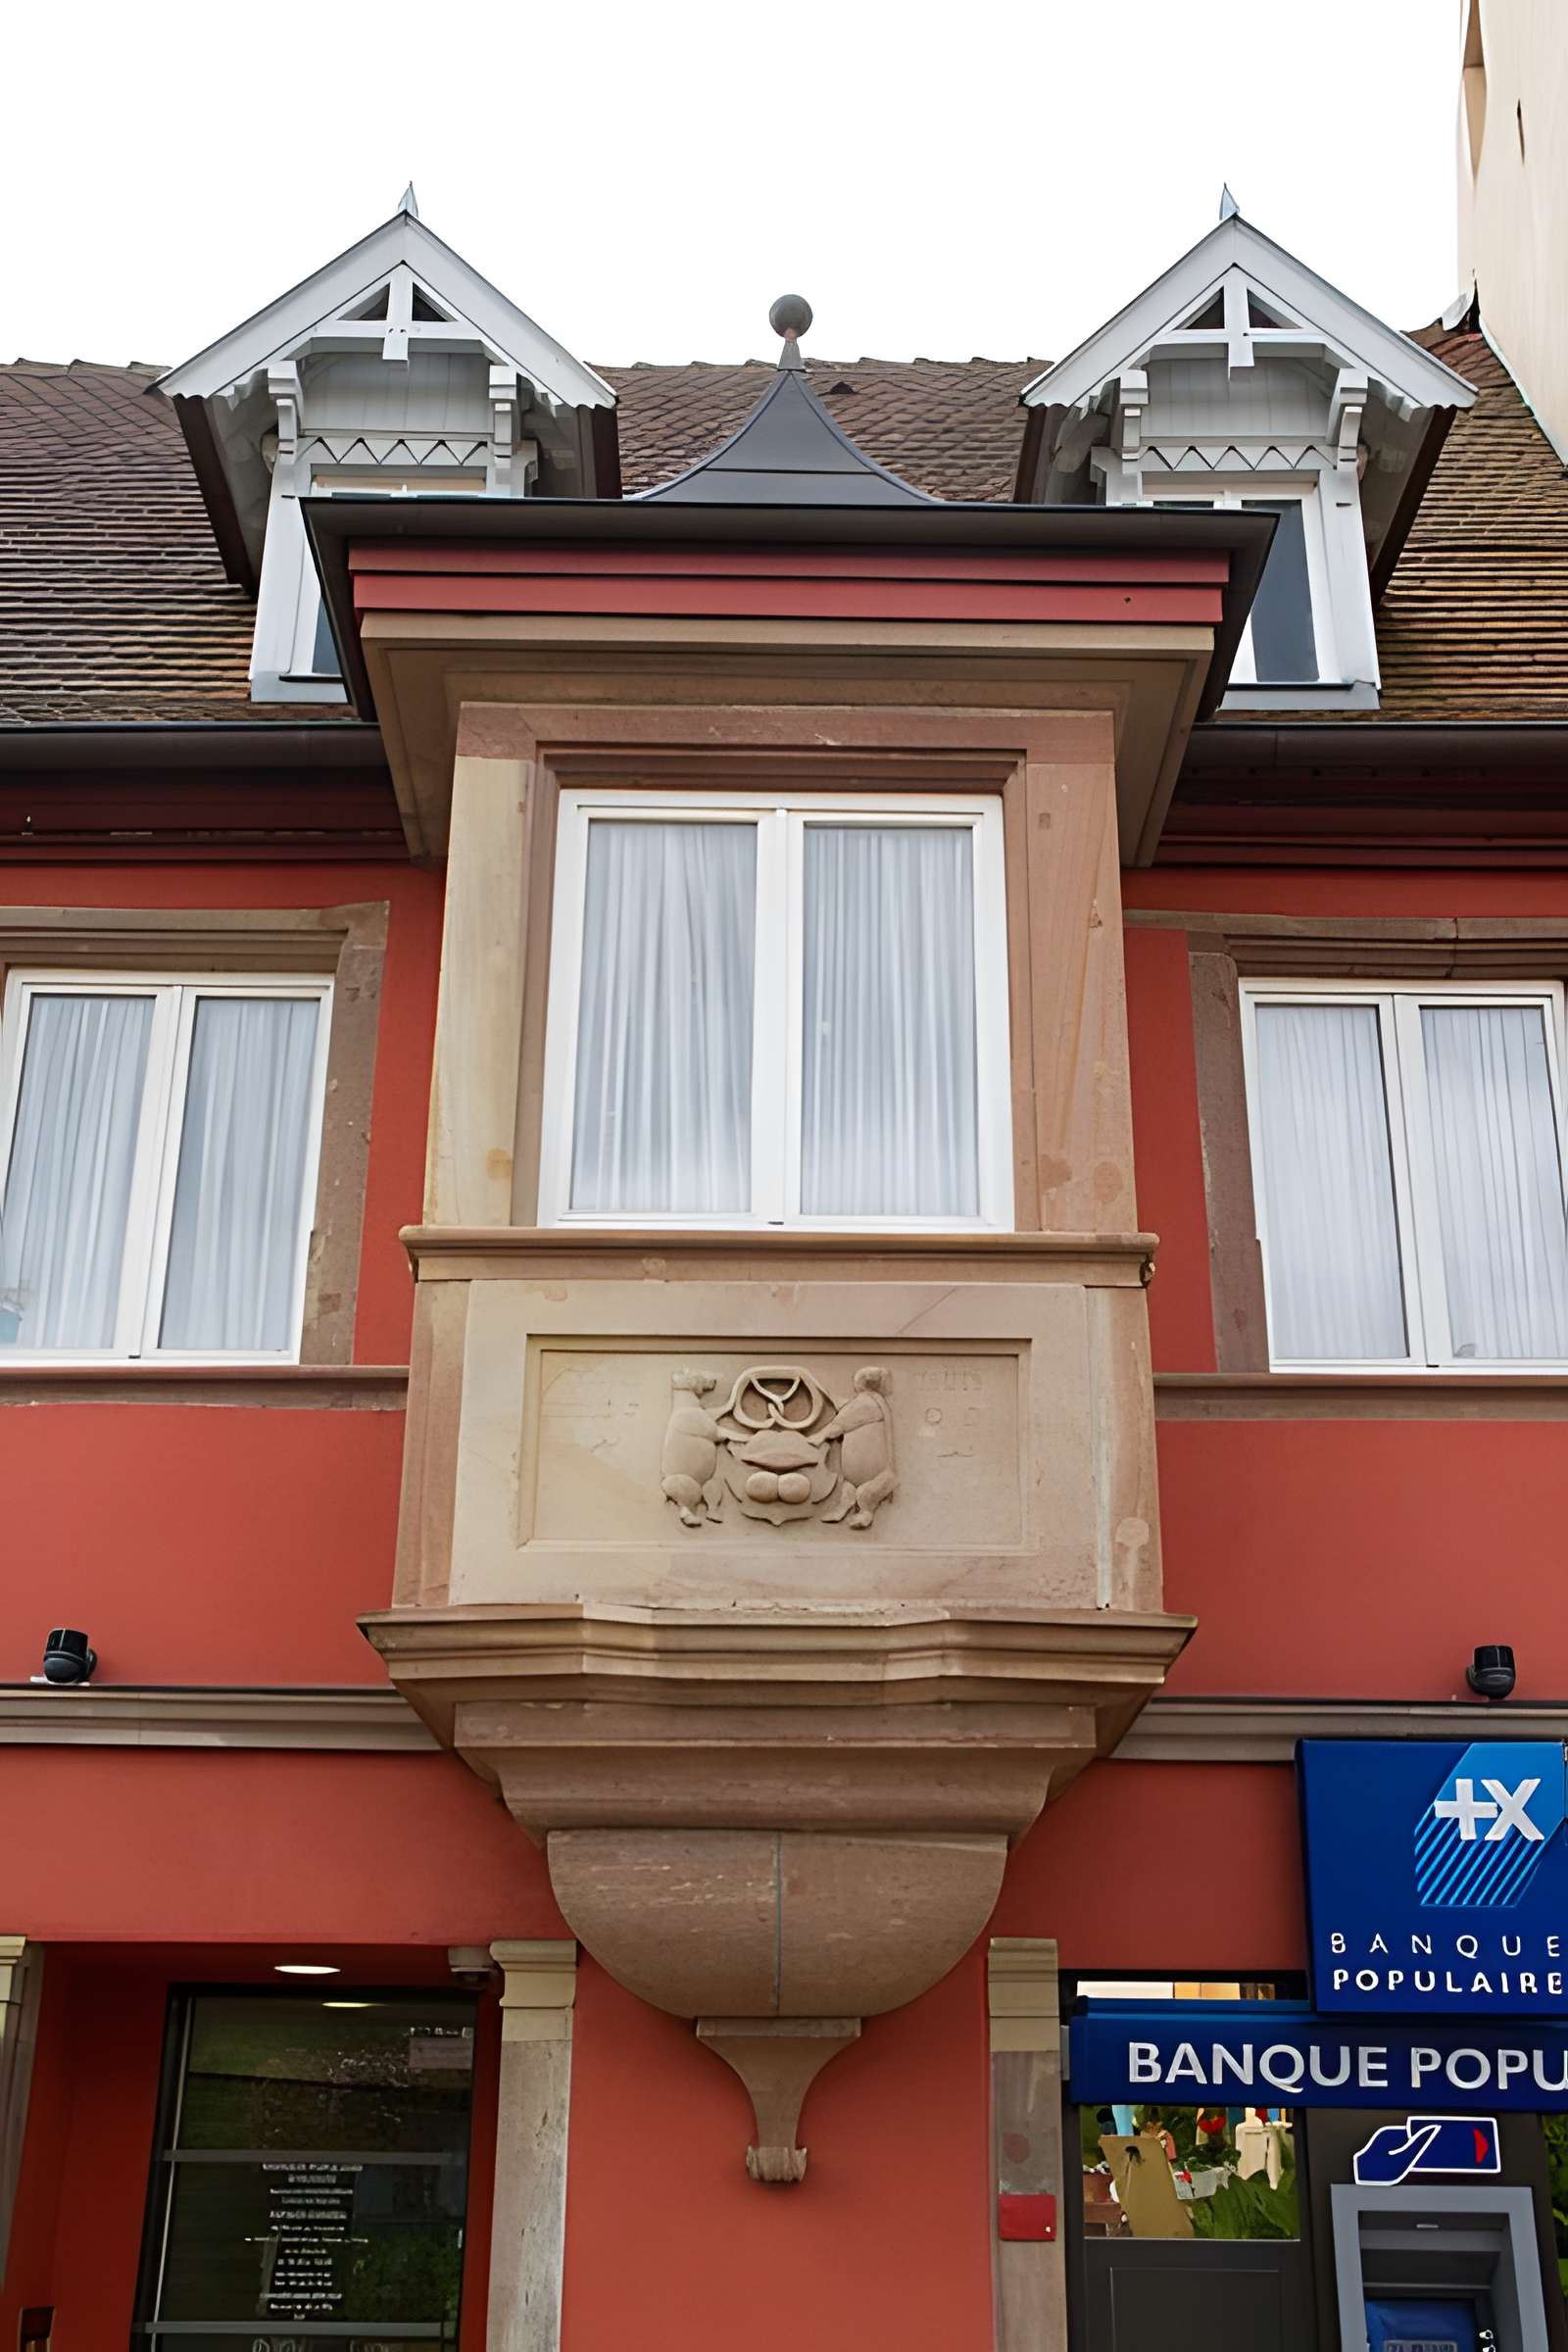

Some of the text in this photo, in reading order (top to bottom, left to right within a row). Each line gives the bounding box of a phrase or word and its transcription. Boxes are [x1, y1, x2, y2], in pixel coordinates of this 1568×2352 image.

[1331, 1933, 1561, 1959] BANQUE
[1333, 1969, 1563, 1995] POPULAIRE
[1129, 2041, 1568, 2093] BANQUE POPU
